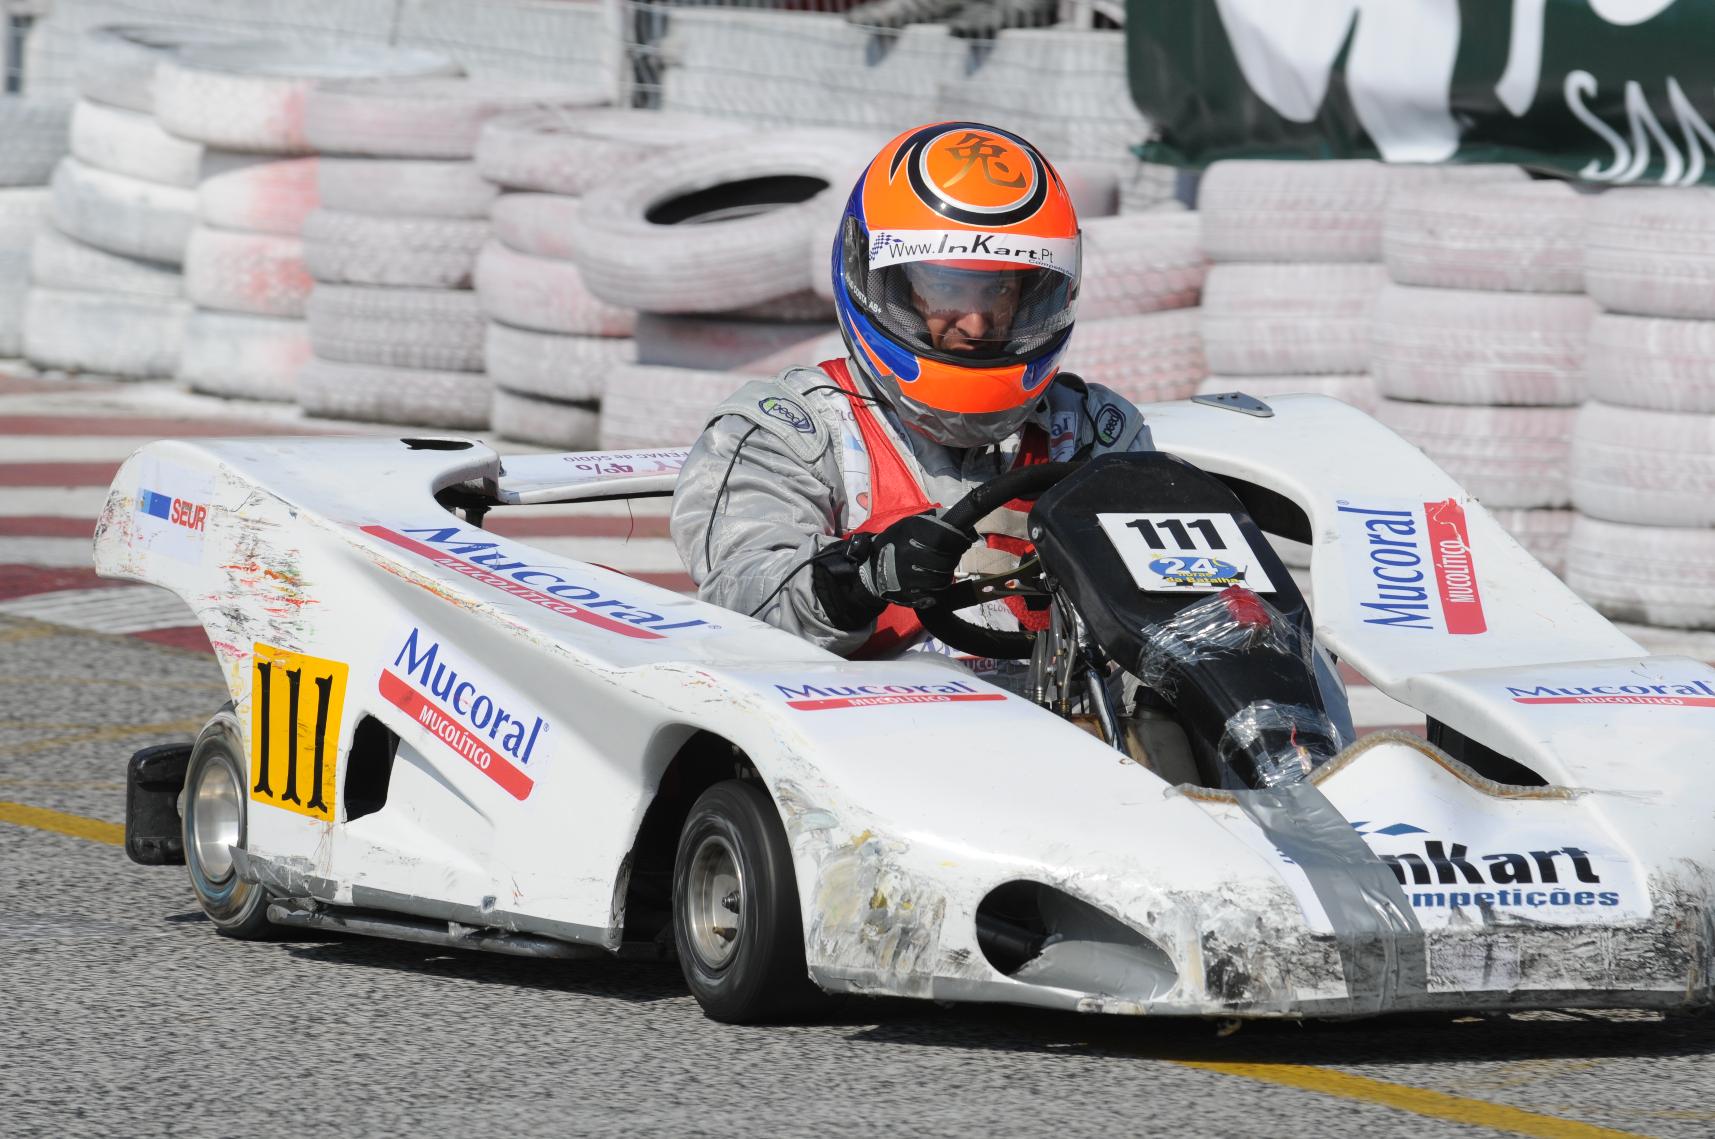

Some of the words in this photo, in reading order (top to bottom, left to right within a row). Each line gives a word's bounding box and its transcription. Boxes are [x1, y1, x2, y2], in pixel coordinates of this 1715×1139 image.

[171, 498, 207, 533] SEUR
[1125, 519, 1228, 550] 111
[402, 527, 711, 631] Mucoral
[1159, 558, 1219, 577] 24
[1337, 505, 1434, 630] Mucoral
[394, 627, 544, 765] Mucoral
[774, 681, 978, 699] Mucoral
[1505, 680, 1715, 697] Mucoral
[418, 704, 492, 770] MUCOLÍTICO
[1378, 840, 1600, 885] nKart
[1406, 887, 1620, 910] mpetições
